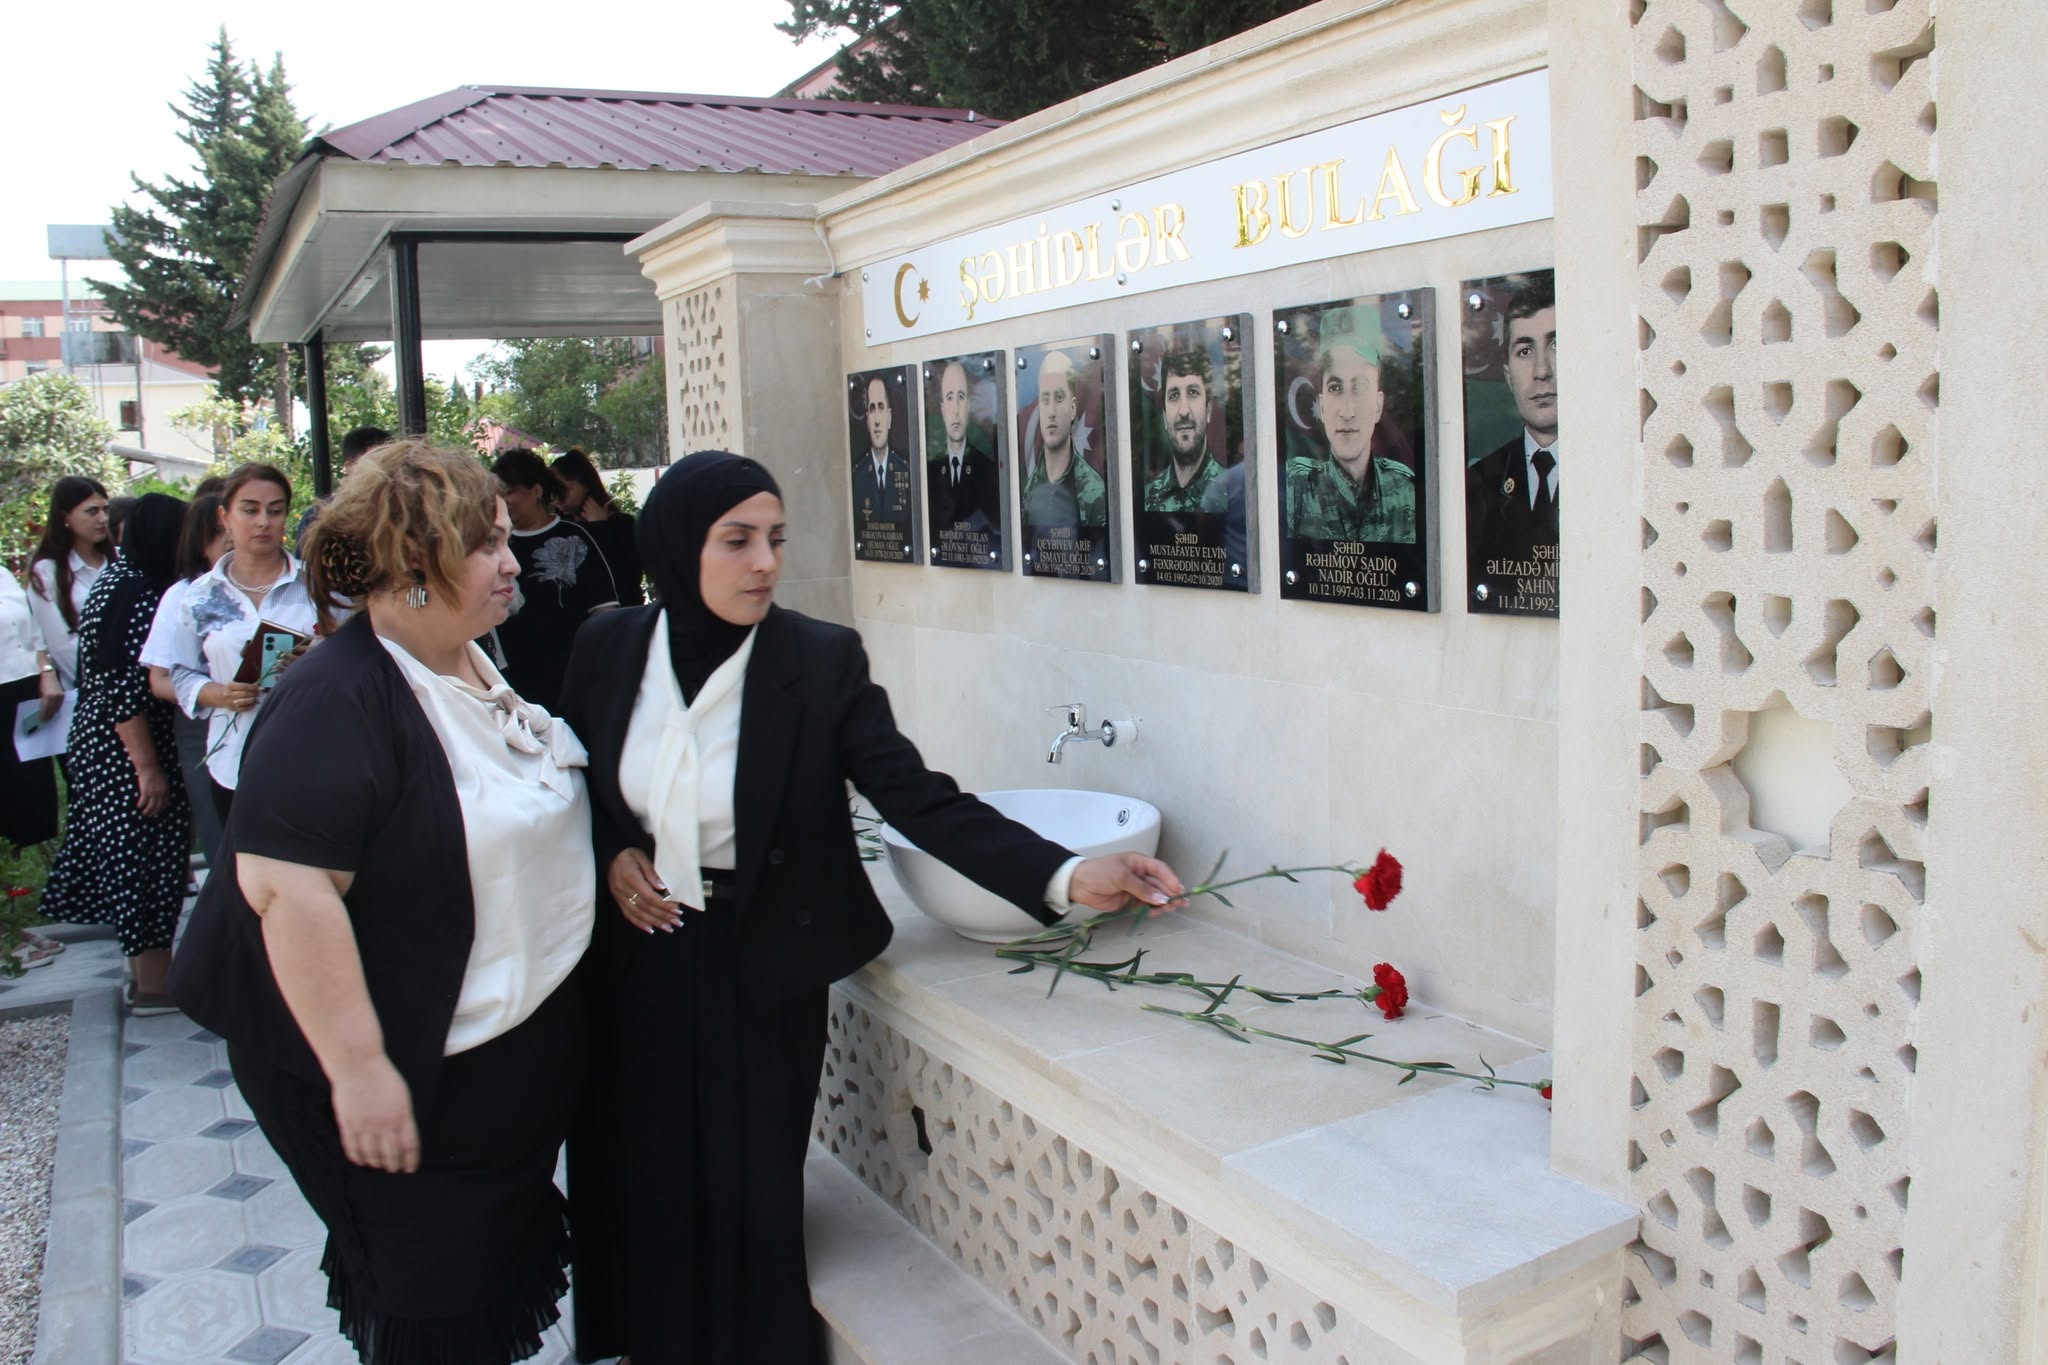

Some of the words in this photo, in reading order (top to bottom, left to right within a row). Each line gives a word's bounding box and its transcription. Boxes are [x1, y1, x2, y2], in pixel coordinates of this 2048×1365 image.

[959, 202, 1193, 320] ŞƏHİDLƏR
[1231, 103, 1520, 248] BULAĞI
[1050, 527, 1070, 539] ŞƏHİD
[1174, 533, 1198, 545] ŞƏHİD
[970, 542, 988, 554] OĞLU
[1073, 540, 1091, 551] ARİF
[1150, 544, 1200, 557] MUSTAFAYEV
[1202, 545, 1227, 559] ELVİN
[1333, 540, 1365, 556] ŞƏHİD
[1532, 544, 1560, 563] ŞƏHİ
[1069, 551, 1089, 565] OĞLU
[1153, 558, 1200, 571] FƏXRƏDDİN
[1201, 560, 1225, 574] OĞLU
[1306, 553, 1358, 570] RƏHİMOV
[1361, 555, 1397, 575] SADİQ
[1486, 557, 1541, 577] ƏLİZADƏ
[1544, 559, 1559, 578] Mİ
[1319, 568, 1354, 585] NADİR
[1356, 570, 1389, 588] OĞLU
[1308, 583, 1400, 602] 10.12.1997-03.11.2020
[1517, 576, 1555, 597] ŞAHİN
[1498, 595, 1559, 612] 11.12.1992-
